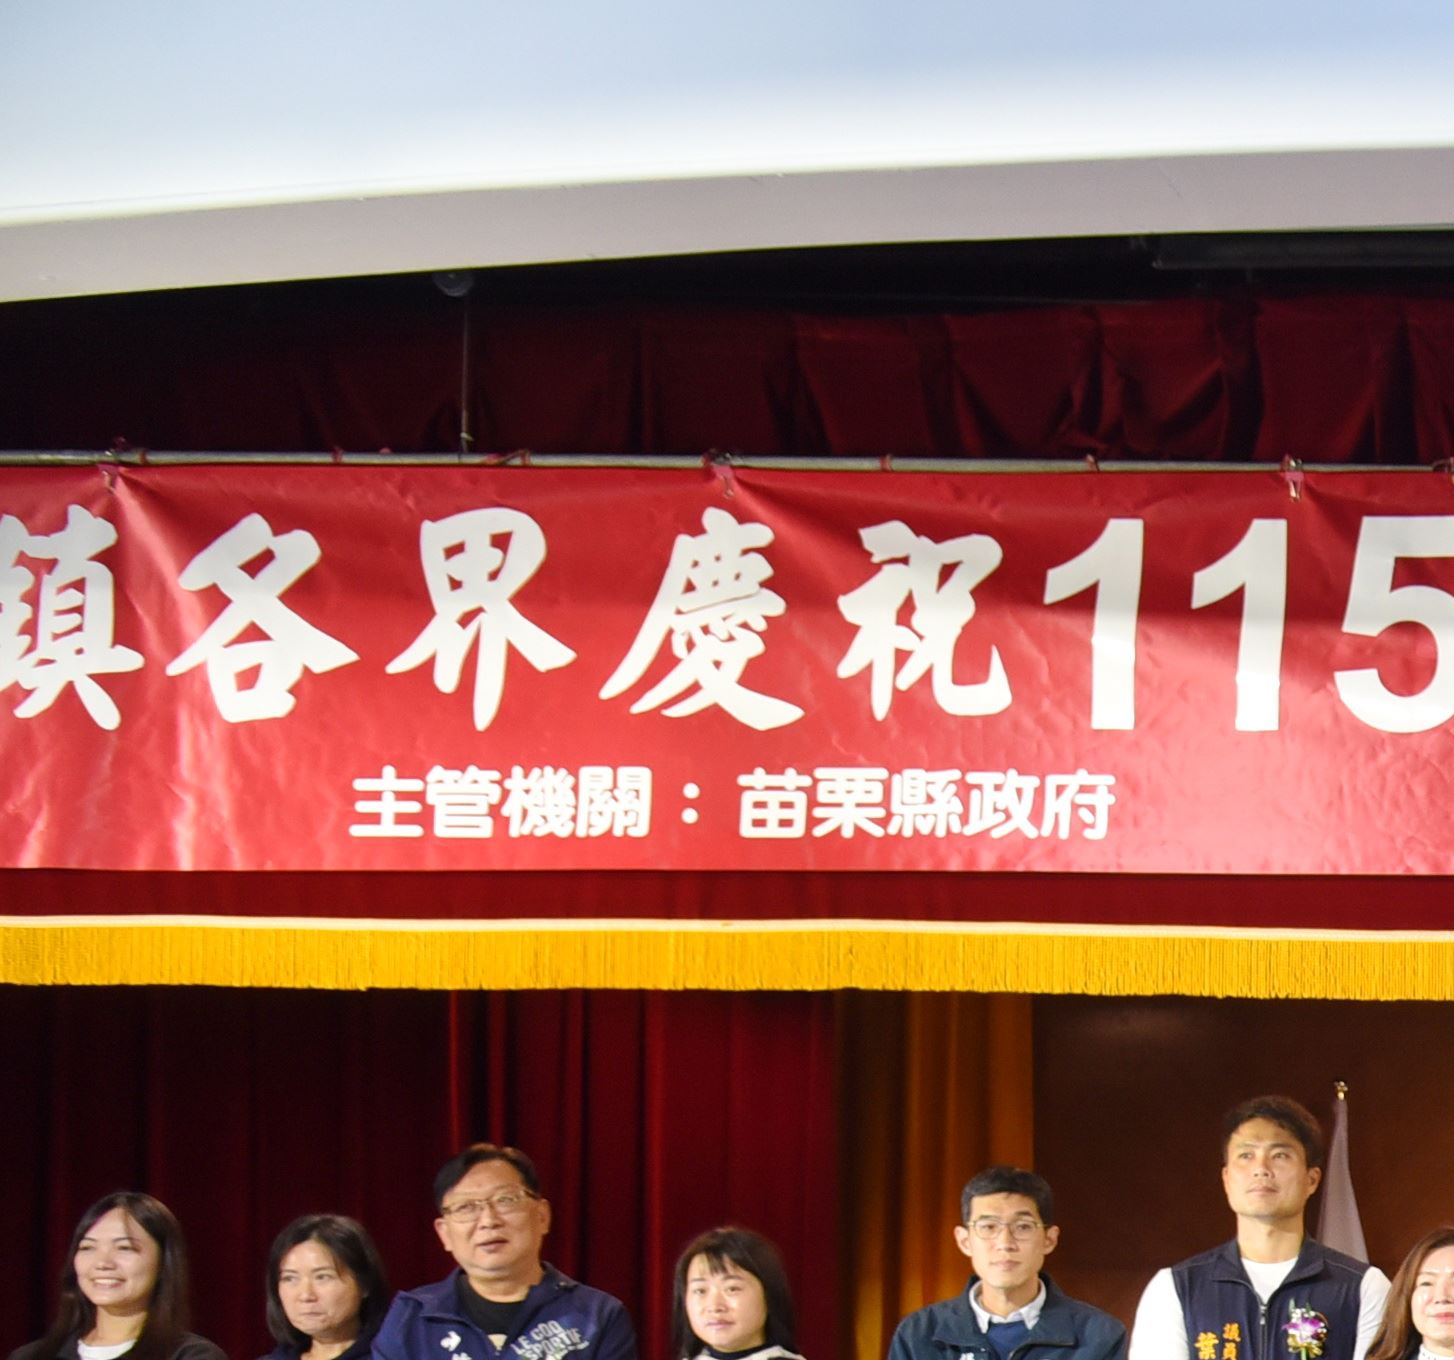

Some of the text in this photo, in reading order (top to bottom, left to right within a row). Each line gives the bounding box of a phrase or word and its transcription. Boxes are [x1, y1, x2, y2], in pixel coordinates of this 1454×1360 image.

[351, 766, 1115, 842] 主管機關：苗栗縣政府
